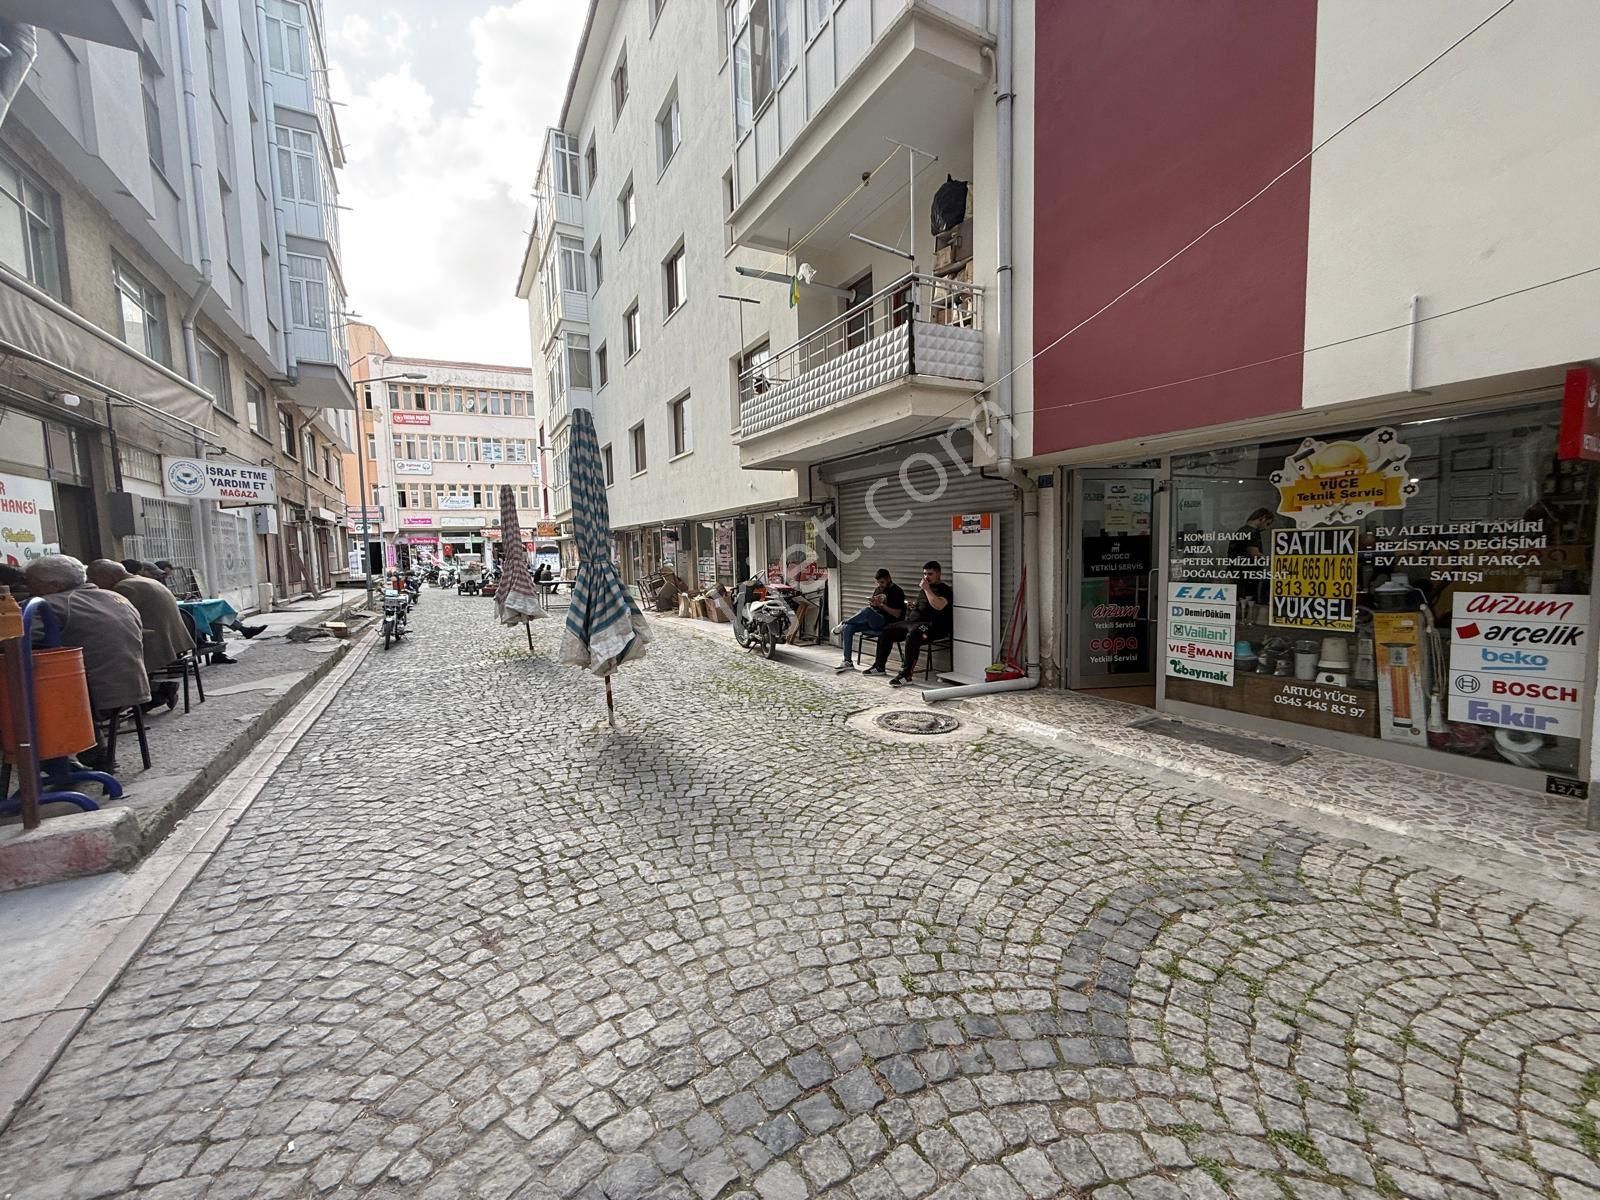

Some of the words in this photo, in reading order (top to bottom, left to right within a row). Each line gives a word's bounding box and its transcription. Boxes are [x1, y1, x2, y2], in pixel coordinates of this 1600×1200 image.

[206, 464, 236, 478] İSRAF
[240, 470, 268, 480] ETME
[210, 478, 251, 489] YARDIM
[254, 482, 266, 490] ET
[1320, 478, 1359, 490] YÜCE
[220, 489, 258, 498] MAĞAZA
[1297, 490, 1336, 501] Teknik
[1340, 487, 1384, 499] Servis
[1376, 526, 1396, 537] EV
[1398, 522, 1476, 536] ALETLERİ
[1476, 519, 1543, 533] TAMİRİ
[1184, 532, 1216, 542] KOMBİ
[1218, 532, 1251, 541] BAKIM
[1276, 530, 1354, 555] SATILIK
[1375, 538, 1460, 551] REZİSTANS
[1464, 534, 1547, 551] DEĞİŞİMİ
[1183, 545, 1212, 554] ARIZA
[1091, 564, 1117, 572] YETKİLİ
[1119, 563, 1143, 571] SERVİS
[1184, 558, 1214, 566] PETEK
[1218, 555, 1269, 567] TEMİZLİĞİ
[1374, 557, 1394, 566] EV
[1397, 553, 1474, 566] ALETLERİ
[1478, 555, 1541, 568] PARÇA
[1182, 569, 1240, 579] DOĞALGAZ
[1302, 558, 1321, 580] 665
[1324, 559, 1335, 580] 01
[1340, 558, 1352, 580] 66
[1430, 571, 1483, 584] SATIŞI
[1275, 581, 1302, 596] 813
[1308, 582, 1326, 597] 30
[1332, 582, 1352, 597] 30
[1092, 603, 1140, 619] arzum
[1184, 607, 1231, 619] DemirDöküm
[1274, 597, 1352, 620] YÜKSEL
[1466, 594, 1574, 620] arzum
[1115, 620, 1136, 628] Servisi
[1273, 617, 1336, 628] EMLAK
[1184, 625, 1228, 641] Vaillant
[1484, 625, 1584, 646] arçelik
[1090, 637, 1138, 656] copa
[1168, 643, 1232, 660] VIESSMANN
[1114, 654, 1138, 662] Servisi
[1481, 648, 1549, 666] beko
[1182, 664, 1228, 682] baymak
[1282, 685, 1321, 698] ARTUĞ
[1324, 689, 1357, 704] YÜCE
[1492, 680, 1578, 702] BOSCH
[1274, 695, 1302, 707] 0545
[1304, 701, 1328, 712] 445
[1330, 704, 1346, 715] 85
[1350, 708, 1366, 719] 97
[1468, 700, 1559, 730] Fakir
